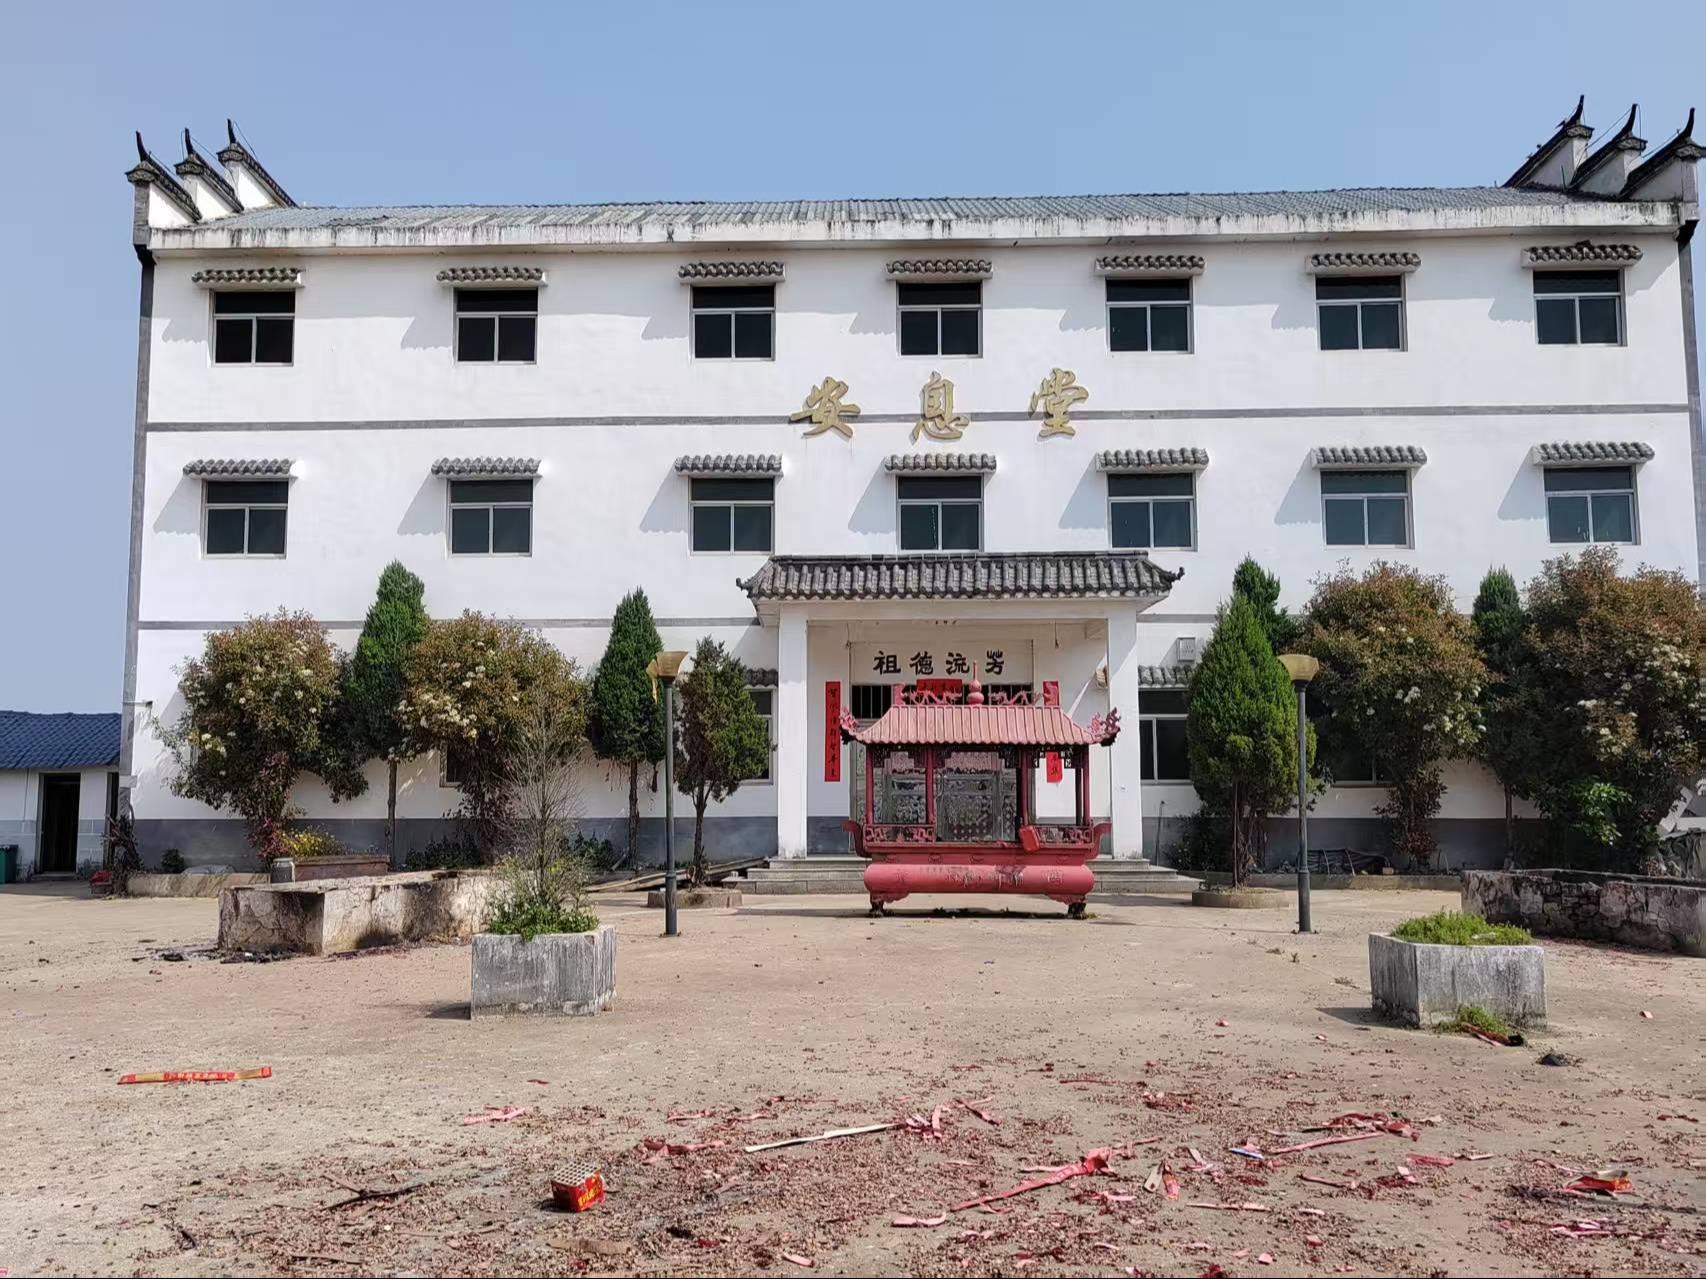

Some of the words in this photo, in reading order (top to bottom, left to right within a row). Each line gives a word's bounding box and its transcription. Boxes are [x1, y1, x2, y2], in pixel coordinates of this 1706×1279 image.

[790, 368, 1089, 441] 安息堂
[873, 649, 1005, 675] 祖德流芳
